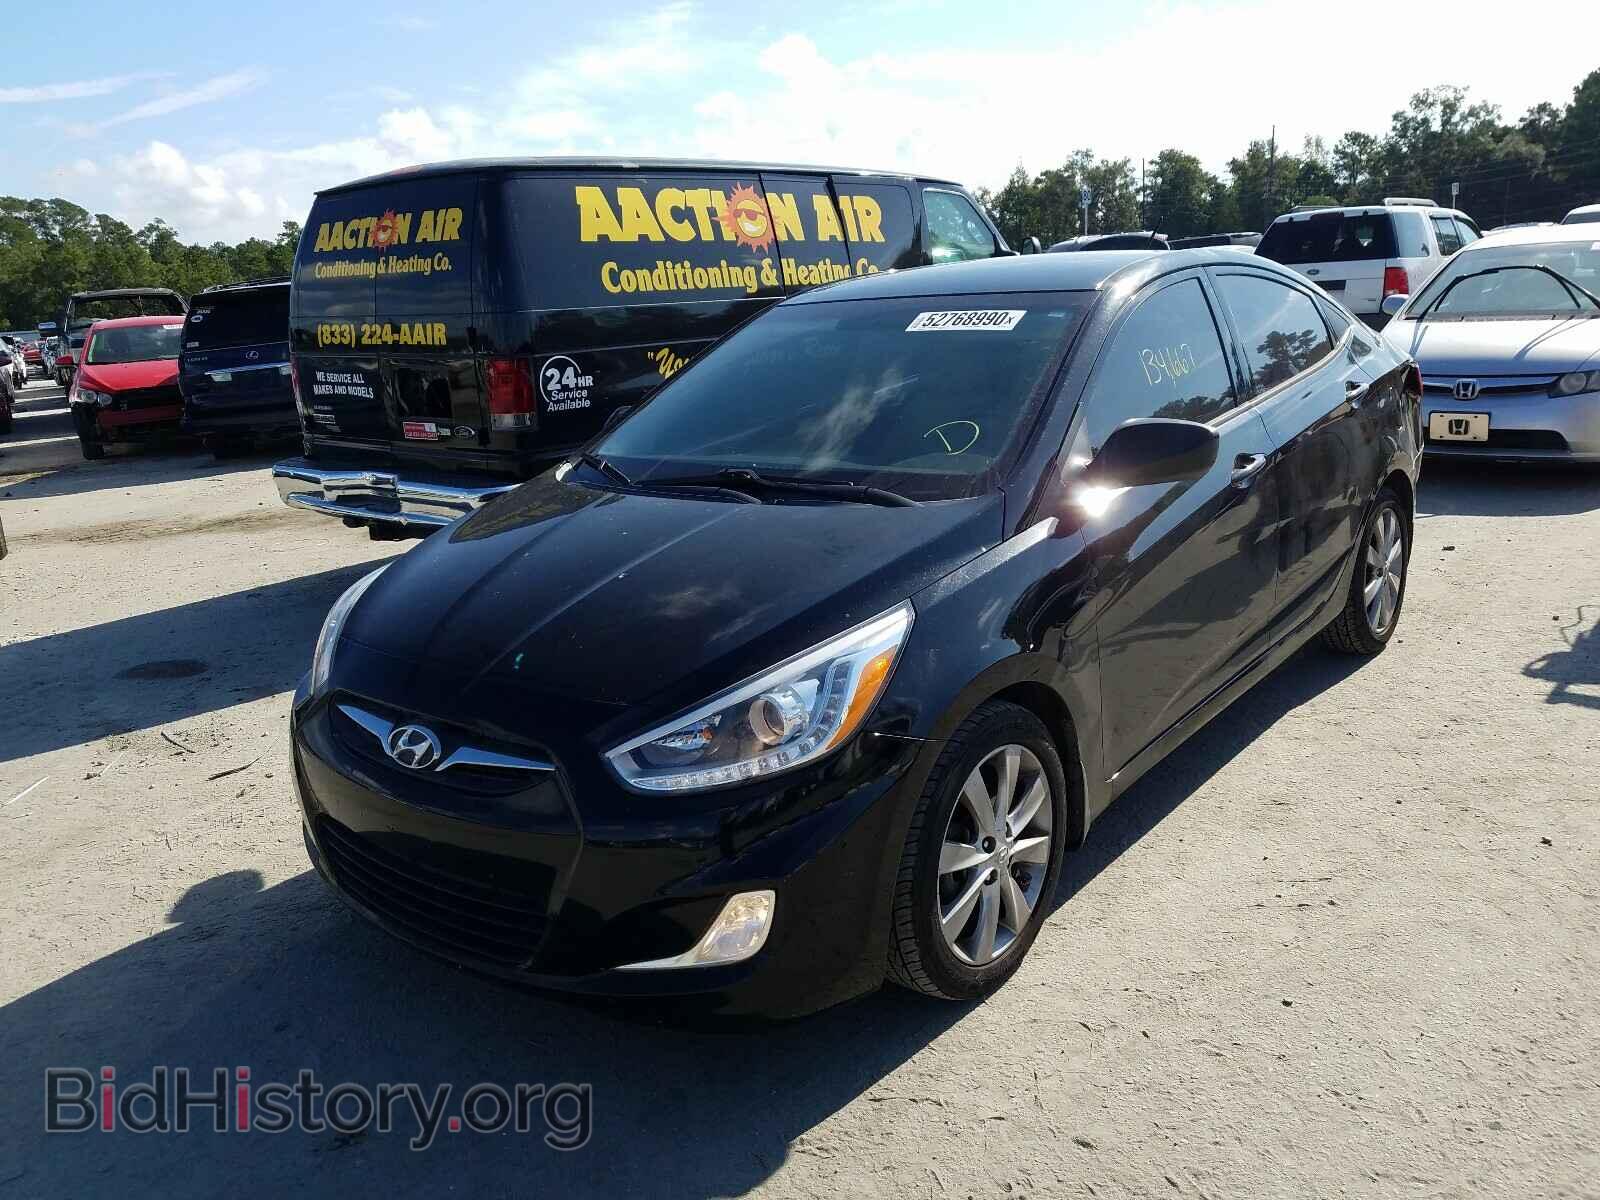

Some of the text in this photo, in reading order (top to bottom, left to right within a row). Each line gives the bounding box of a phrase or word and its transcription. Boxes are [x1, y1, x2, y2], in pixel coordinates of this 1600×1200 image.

[416, 208, 463, 242] AIR
[812, 194, 886, 243] AIR
[314, 252, 453, 279] Conditioning & Heating Co.
[601, 259, 758, 294] Conditioning
[761, 258, 779, 286] &
[316, 323, 447, 348] (833) 224-AAIR
[316, 371, 365, 384] WE SERVICE ALL
[545, 366, 594, 390] 24 HR
[313, 385, 374, 398] MAKES AND MODELS
[551, 388, 588, 400] Service
[547, 398, 591, 412] Available
